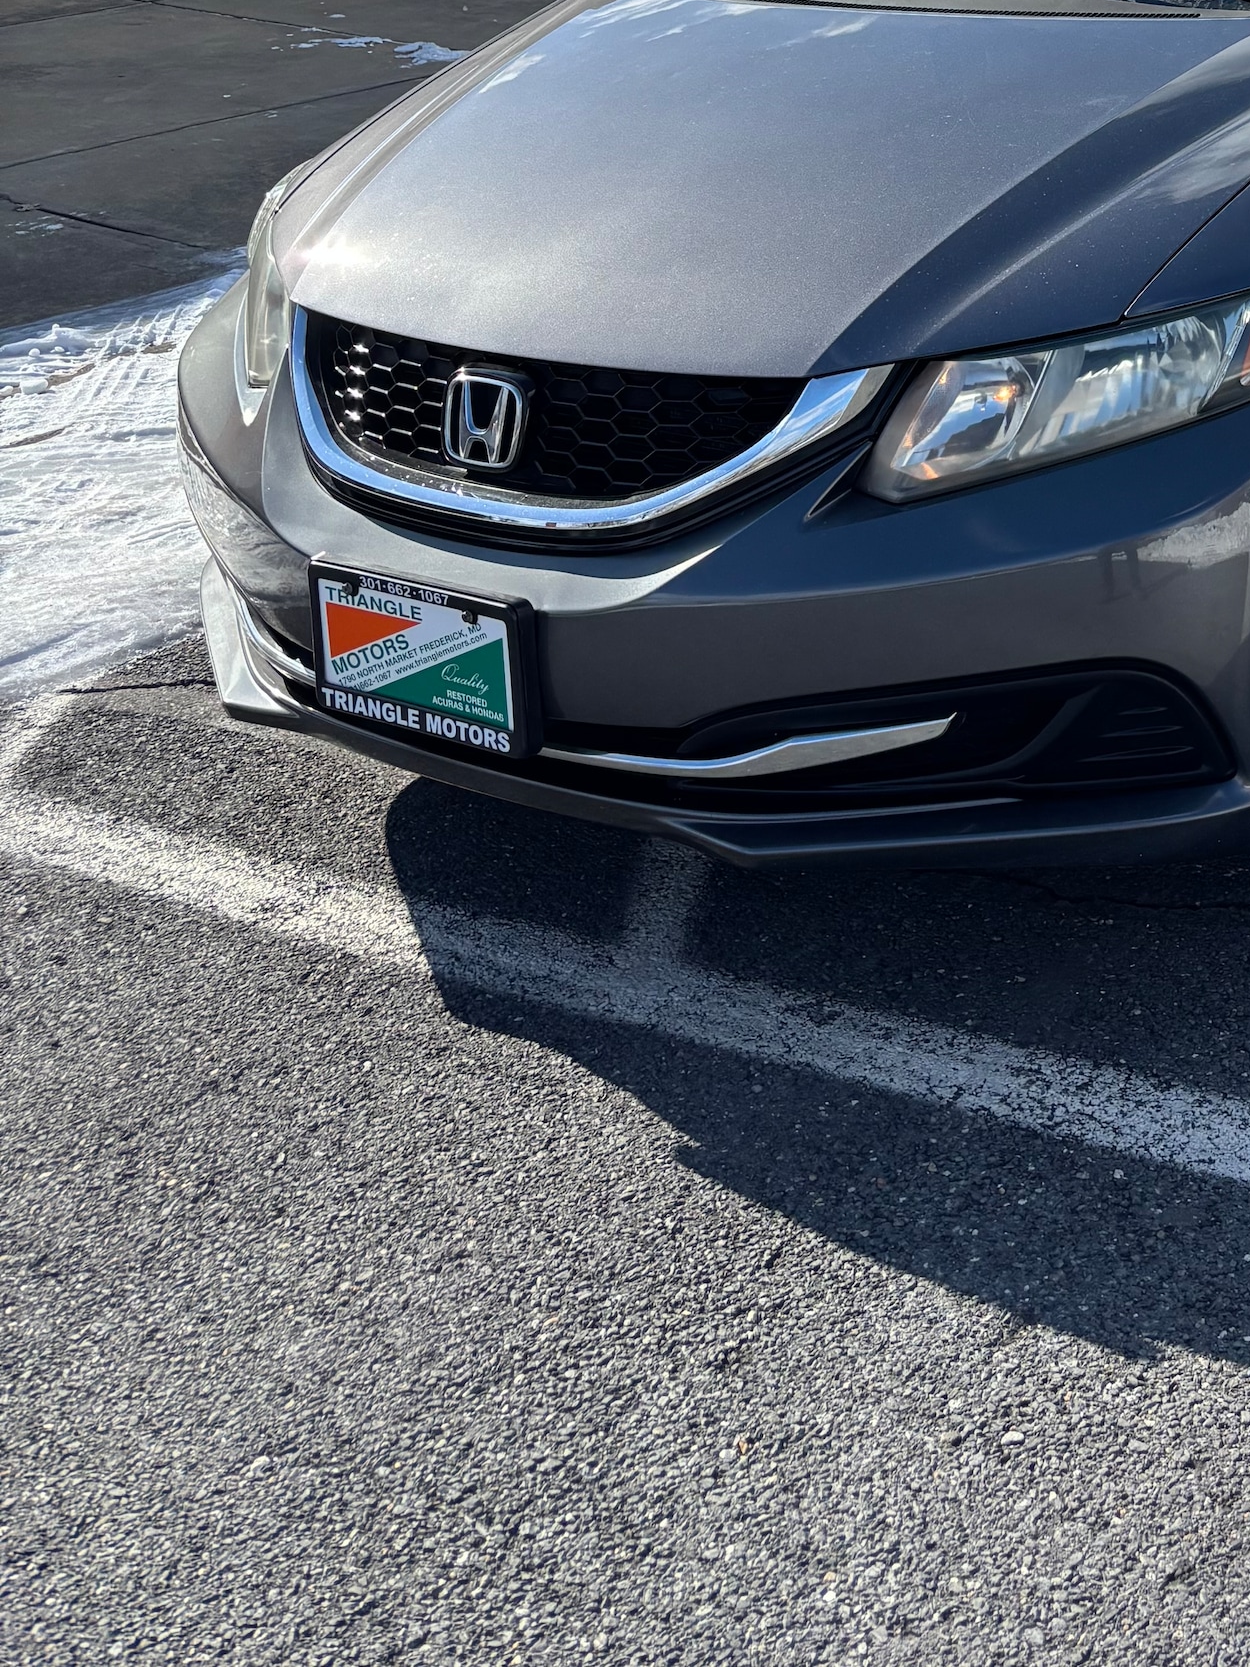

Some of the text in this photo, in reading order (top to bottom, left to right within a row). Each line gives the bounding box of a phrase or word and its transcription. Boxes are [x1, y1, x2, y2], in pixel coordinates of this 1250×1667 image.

[331, 634, 410, 675] MOTORS
[357, 662, 385, 679] NORTH
[385, 647, 418, 668] MARKET
[420, 630, 468, 654] FREDERICK,
[468, 623, 482, 634] MD
[395, 633, 488, 675] www.trianglemotors.com
[441, 663, 490, 696] Quality
[446, 689, 488, 708] RESTORED
[321, 687, 511, 753] TRIANGLE MOTORS
[432, 696, 505, 722] ACURAS & HONDAS
